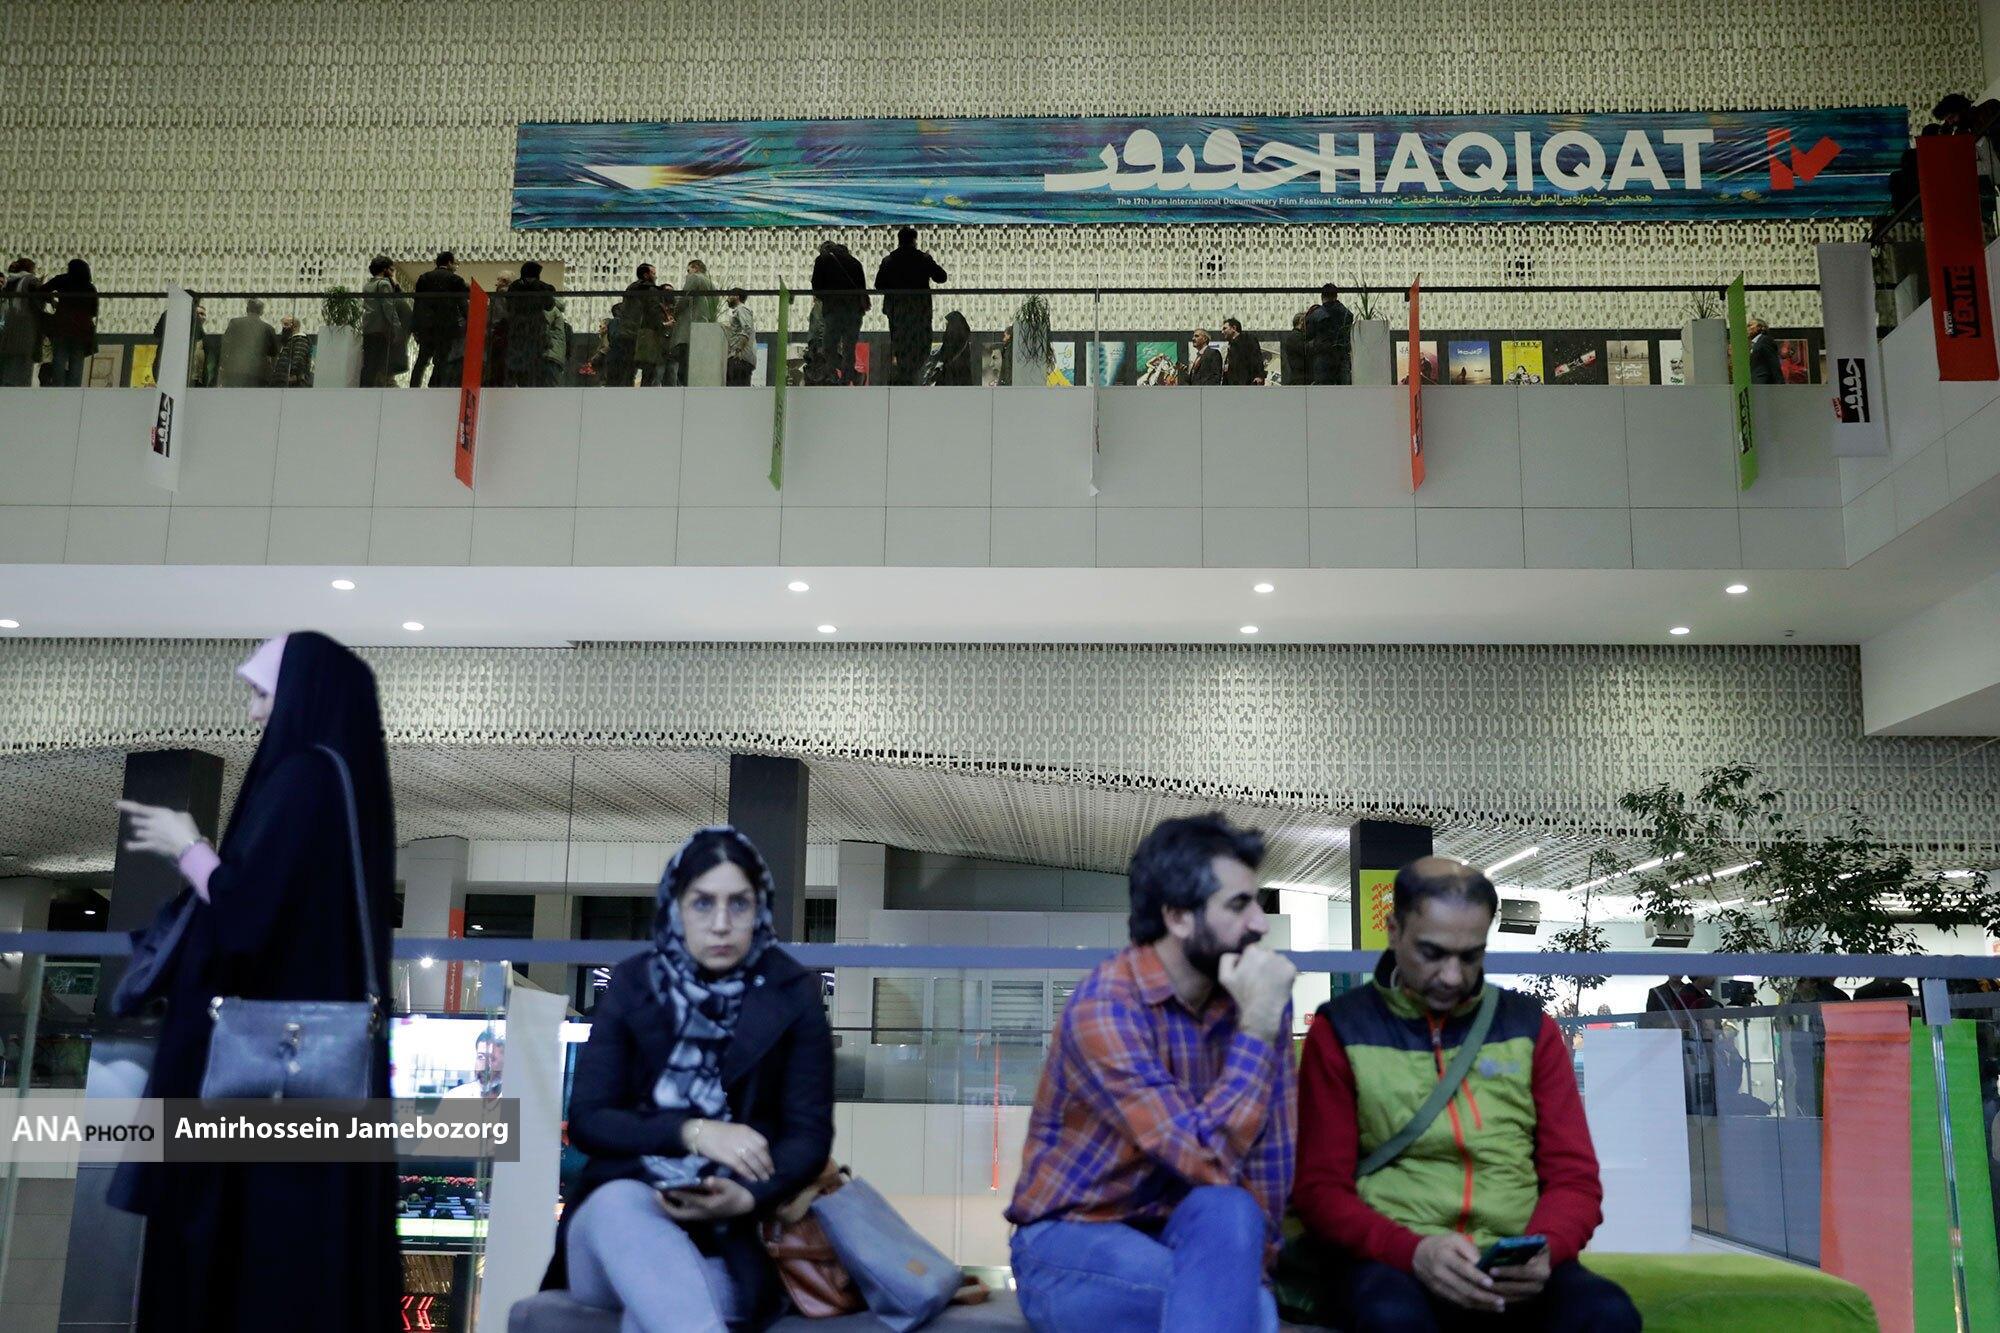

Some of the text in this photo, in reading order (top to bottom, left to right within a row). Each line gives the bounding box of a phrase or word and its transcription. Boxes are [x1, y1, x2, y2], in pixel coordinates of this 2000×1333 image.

[1319, 129, 1714, 193] HAQIQAT
[1116, 197, 1131, 205] The
[1133, 197, 1149, 205] 17th
[1151, 197, 1168, 205] Iran
[1169, 197, 1221, 205] International
[1223, 197, 1276, 206] Documentary
[1279, 197, 1297, 205] Film
[1299, 197, 1331, 205] Festival
[1332, 197, 1367, 205] "Cinema
